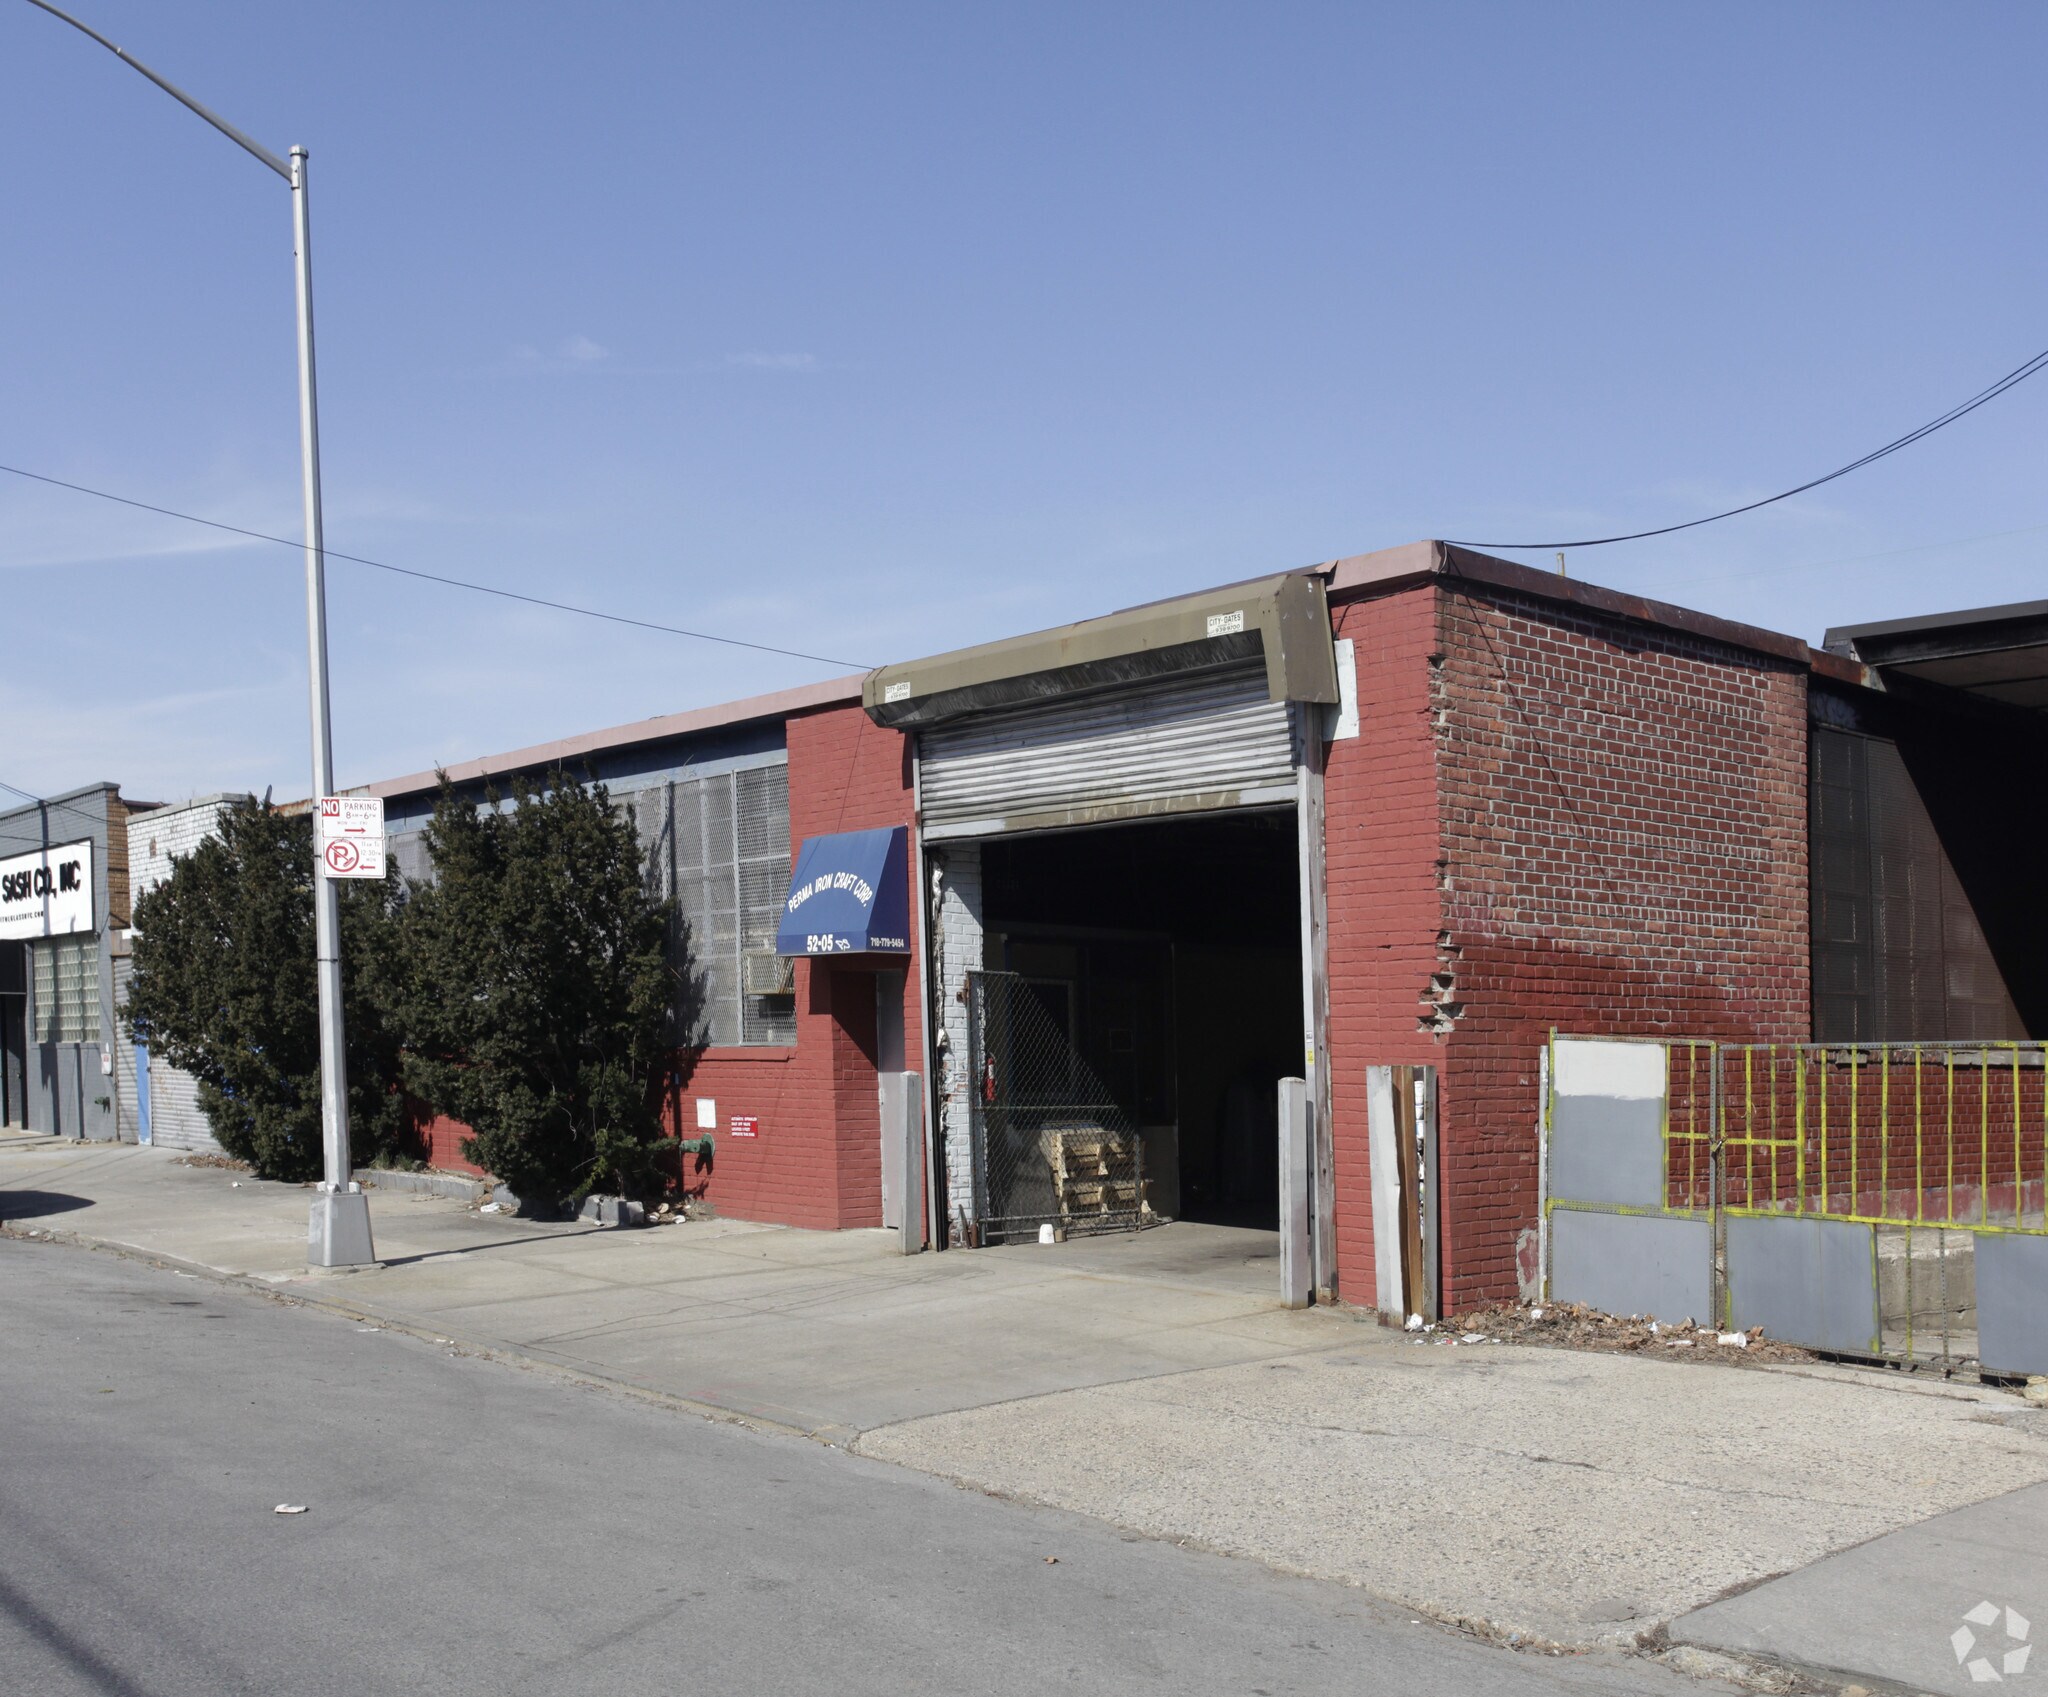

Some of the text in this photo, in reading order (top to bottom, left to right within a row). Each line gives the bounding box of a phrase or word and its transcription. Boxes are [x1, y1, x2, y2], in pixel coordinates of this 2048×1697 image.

[322, 801, 378, 814] NO PARKING
[2, 870, 32, 904] SASH
[59, 860, 81, 893] INC
[788, 872, 873, 913] PERMA IRON CRAFT CORP.
[807, 934, 834, 952] 52-05
